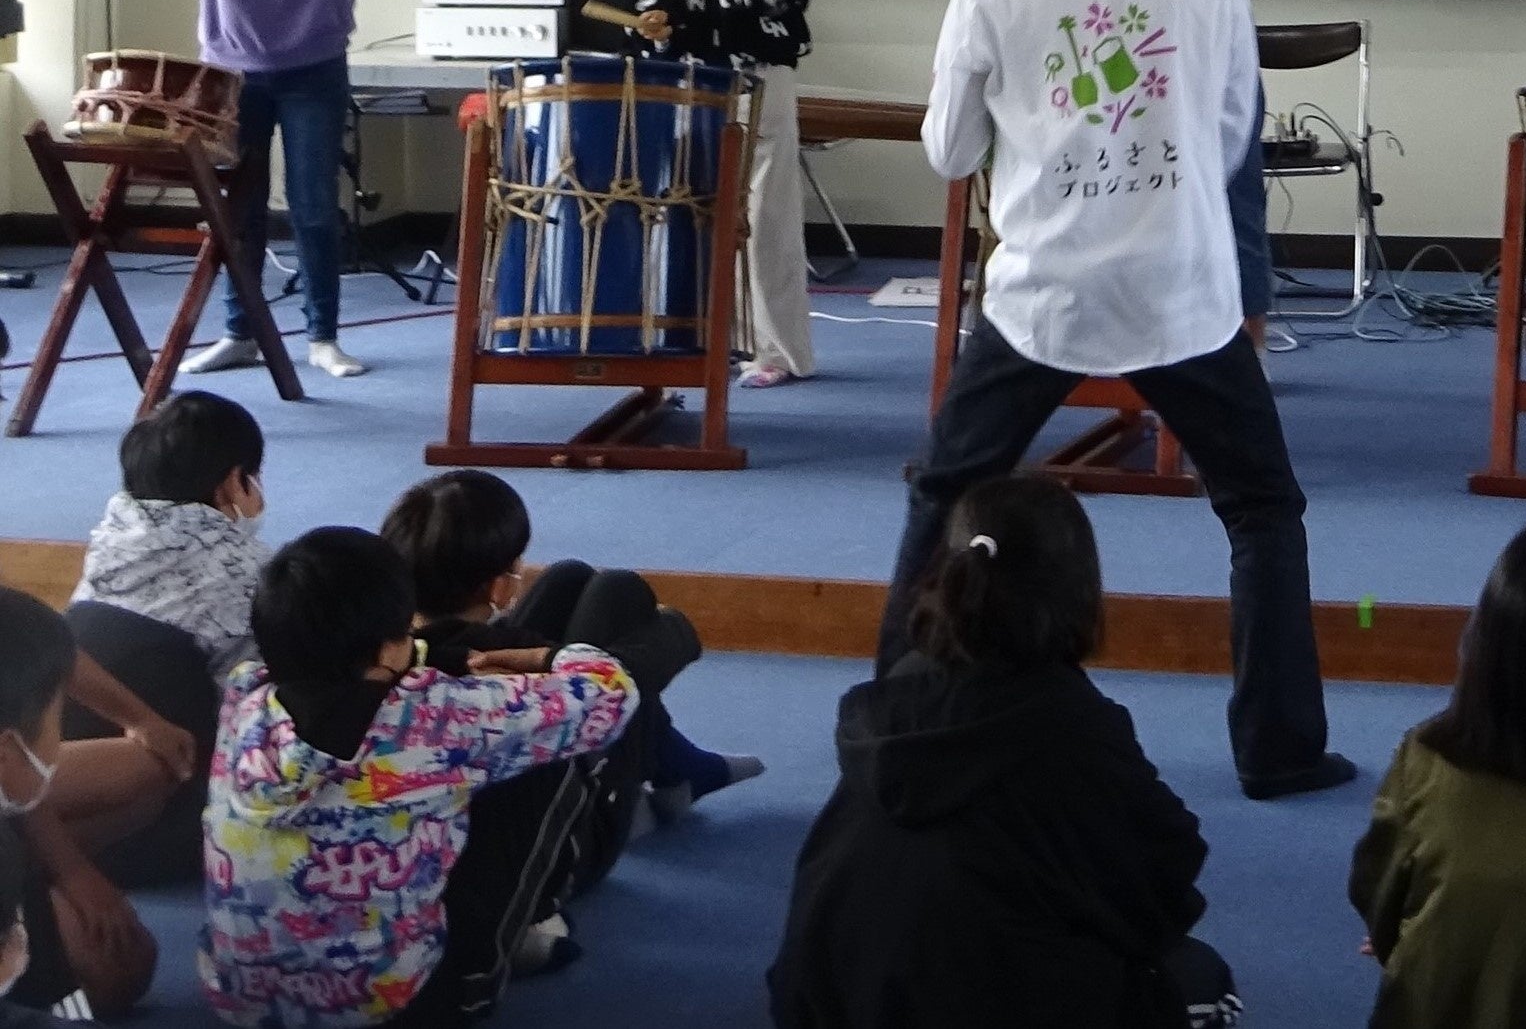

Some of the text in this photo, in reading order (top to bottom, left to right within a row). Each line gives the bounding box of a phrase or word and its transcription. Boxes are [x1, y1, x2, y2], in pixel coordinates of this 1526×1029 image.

[1054, 139, 1179, 173] ふるさと
[1056, 170, 1183, 199] プロジェクト
